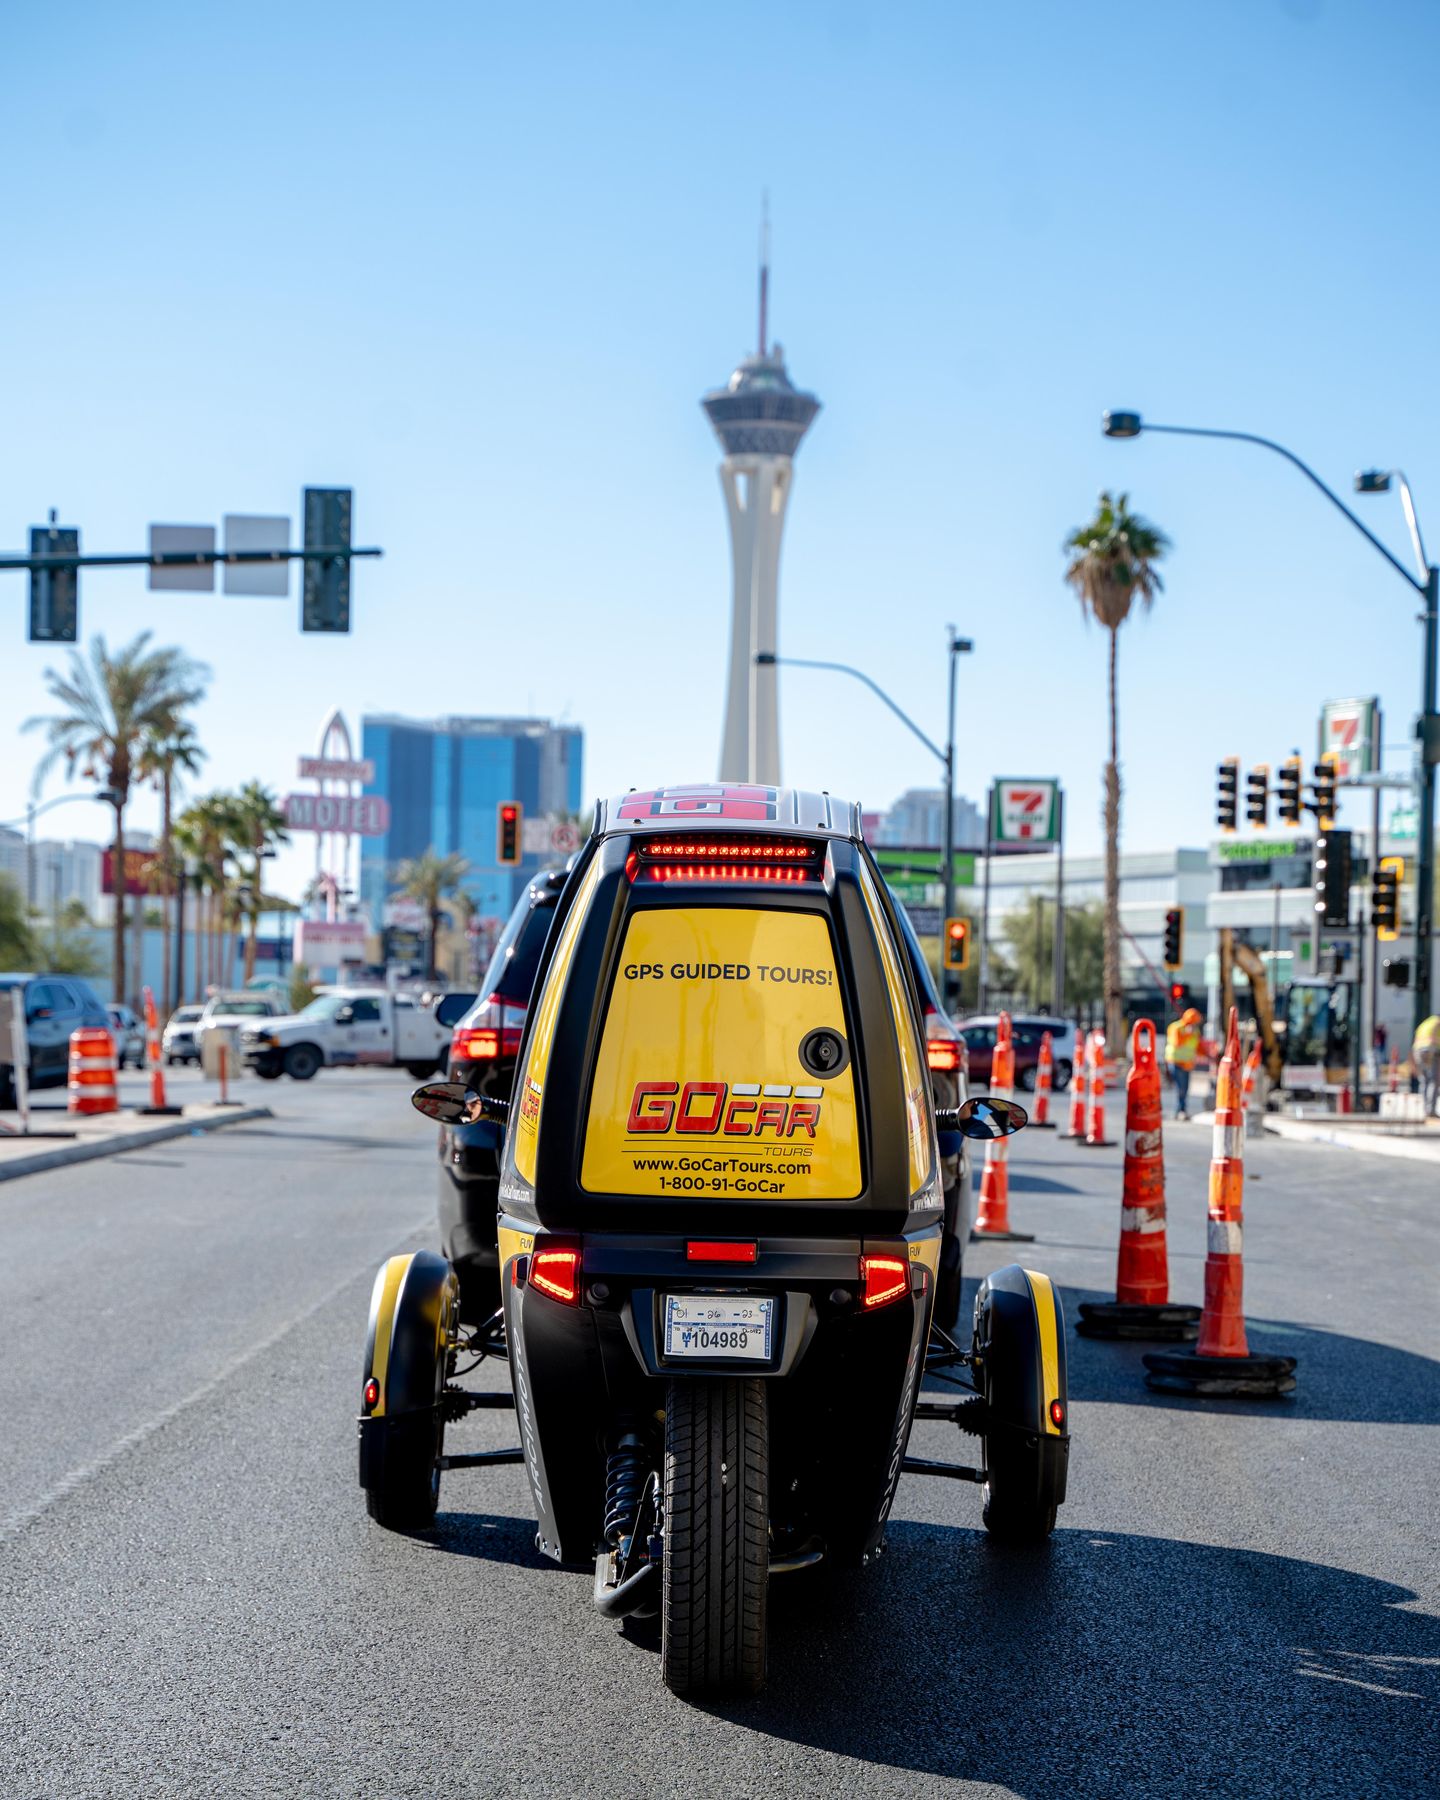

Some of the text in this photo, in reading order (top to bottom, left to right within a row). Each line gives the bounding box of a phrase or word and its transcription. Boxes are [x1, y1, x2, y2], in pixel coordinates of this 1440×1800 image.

[289, 797, 380, 830] MOTEL
[624, 963, 833, 986] GPS GUIDED TOURS!
[626, 1081, 821, 1138] GOCAR
[763, 1146, 813, 1157] TOURS
[633, 1157, 811, 1174] www.GoCarTours.com
[659, 1177, 785, 1193] 1-800-91-GoCar
[520, 1237, 533, 1249] FUV
[676, 1309, 688, 1318] 01
[707, 1310, 720, 1319] 26
[742, 1310, 753, 1319] 23
[692, 1332, 748, 1348] 104989
[514, 1327, 546, 1514] ARCIMOTO
